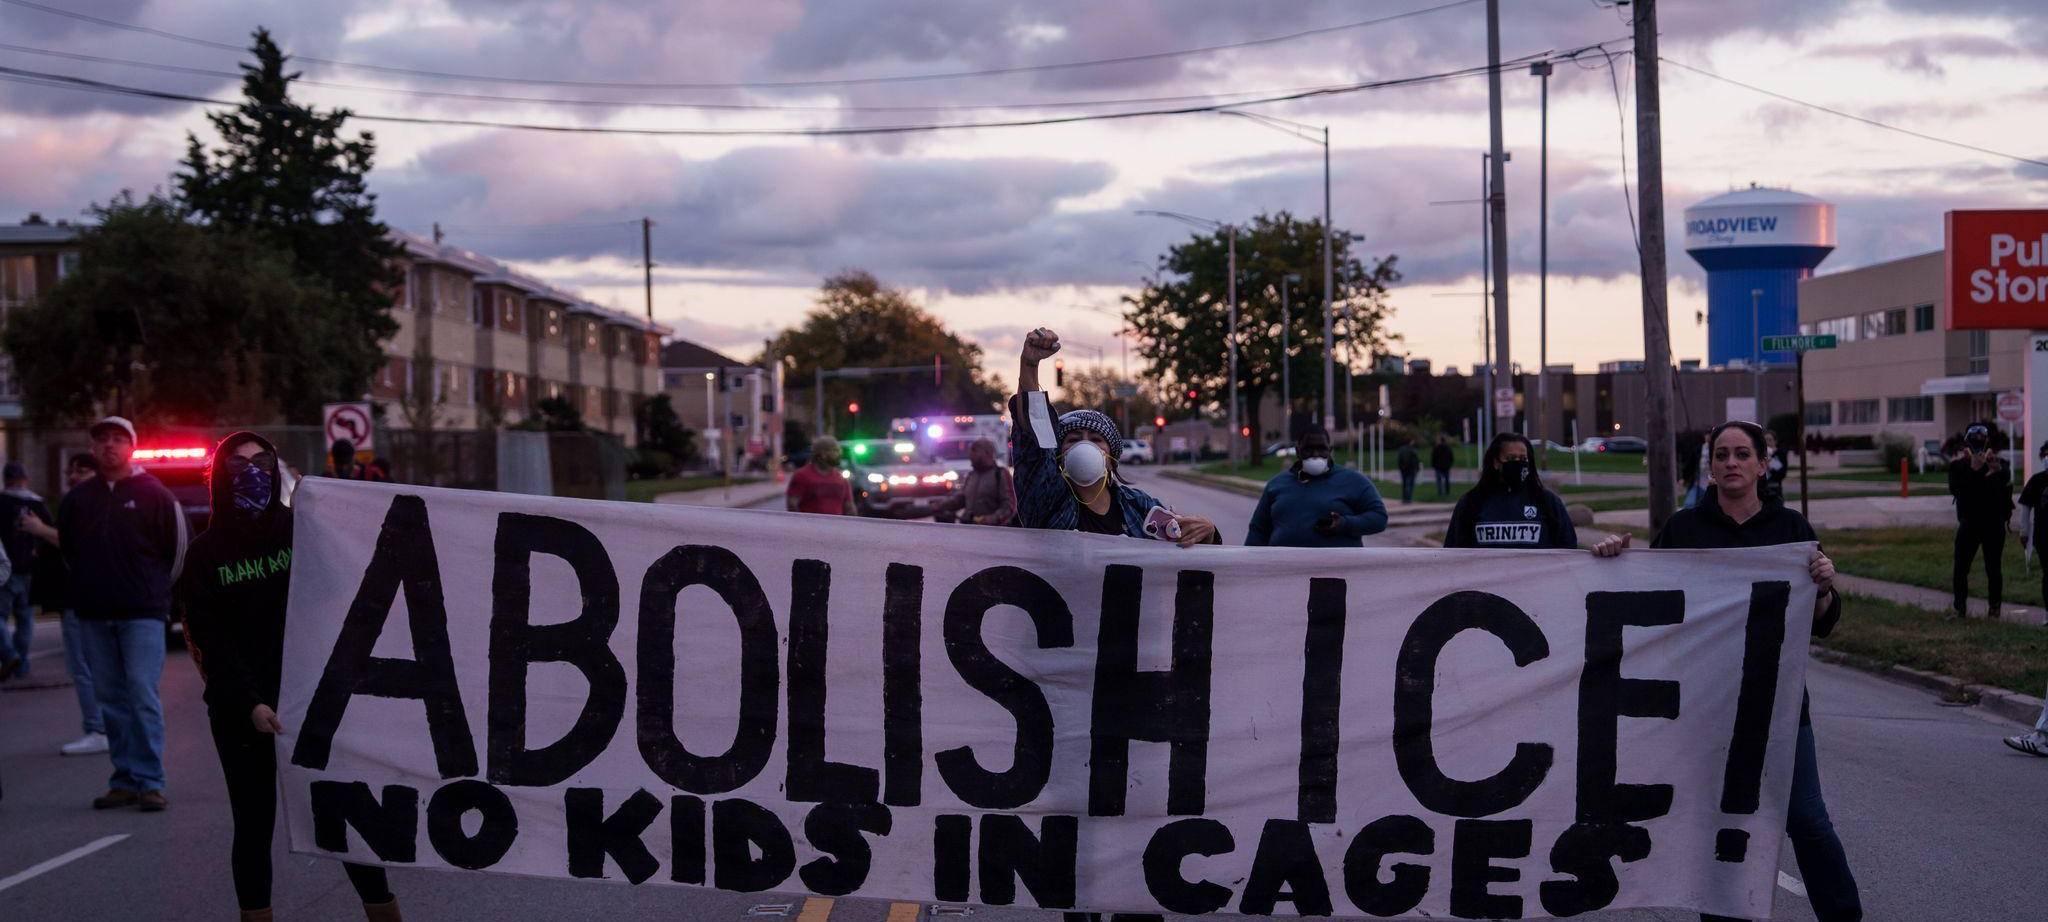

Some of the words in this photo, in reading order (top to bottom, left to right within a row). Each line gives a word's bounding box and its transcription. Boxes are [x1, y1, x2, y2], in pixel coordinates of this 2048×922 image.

[1771, 336, 1815, 350] FILLMORE
[1476, 526, 1539, 540] TRINITY
[217, 556, 266, 586] TRIPPIE
[292, 494, 1214, 817] ABOLISH
[1298, 577, 1790, 863] ICE!
[310, 779, 519, 870] NO
[564, 786, 892, 896] KIDS
[934, 814, 1078, 906] IN
[1142, 814, 1652, 919] CAGES
